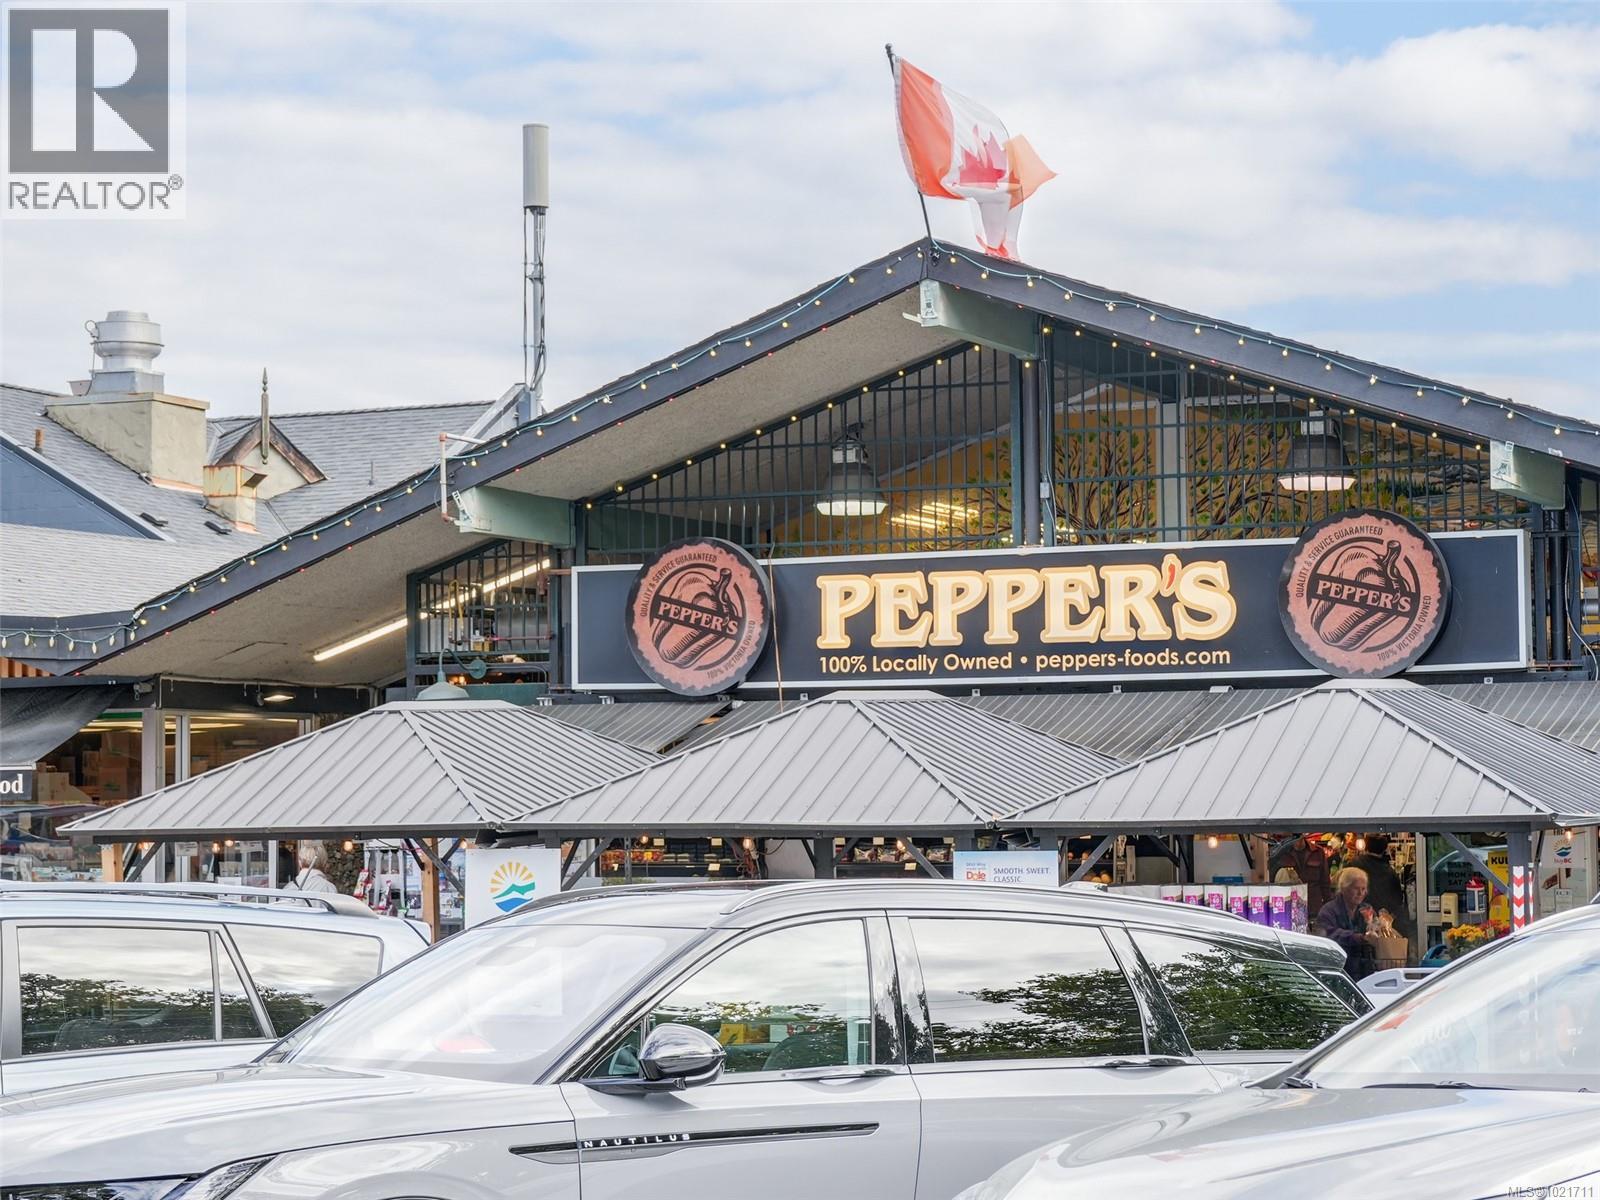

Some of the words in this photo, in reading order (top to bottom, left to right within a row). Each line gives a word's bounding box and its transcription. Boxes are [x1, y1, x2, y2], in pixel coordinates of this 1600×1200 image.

[640, 587, 654, 617] QUALITY
[652, 560, 676, 584] SERVICE
[674, 553, 718, 566] GUARANTEED
[1296, 567, 1309, 598] QUALITY
[1308, 534, 1335, 561] SERVICE
[1333, 525, 1383, 541] GUARANTEED
[658, 601, 738, 635] PEPPER'S
[817, 553, 1237, 649] PEPPER'S
[1316, 580, 1411, 612] PEPPER'S
[723, 646, 746, 671] VICTORIA
[743, 620, 755, 646] OWNED
[1377, 648, 1398, 661] 100%
[1395, 623, 1423, 651] VICTORIA
[1418, 595, 1431, 622] OWNED
[819, 656, 867, 673] 100%
[873, 654, 938, 675] Locally
[943, 652, 1012, 671] Owned
[1036, 648, 1231, 673] peppers-foods.com
[583, 1133, 690, 1148] NAUTILUS
